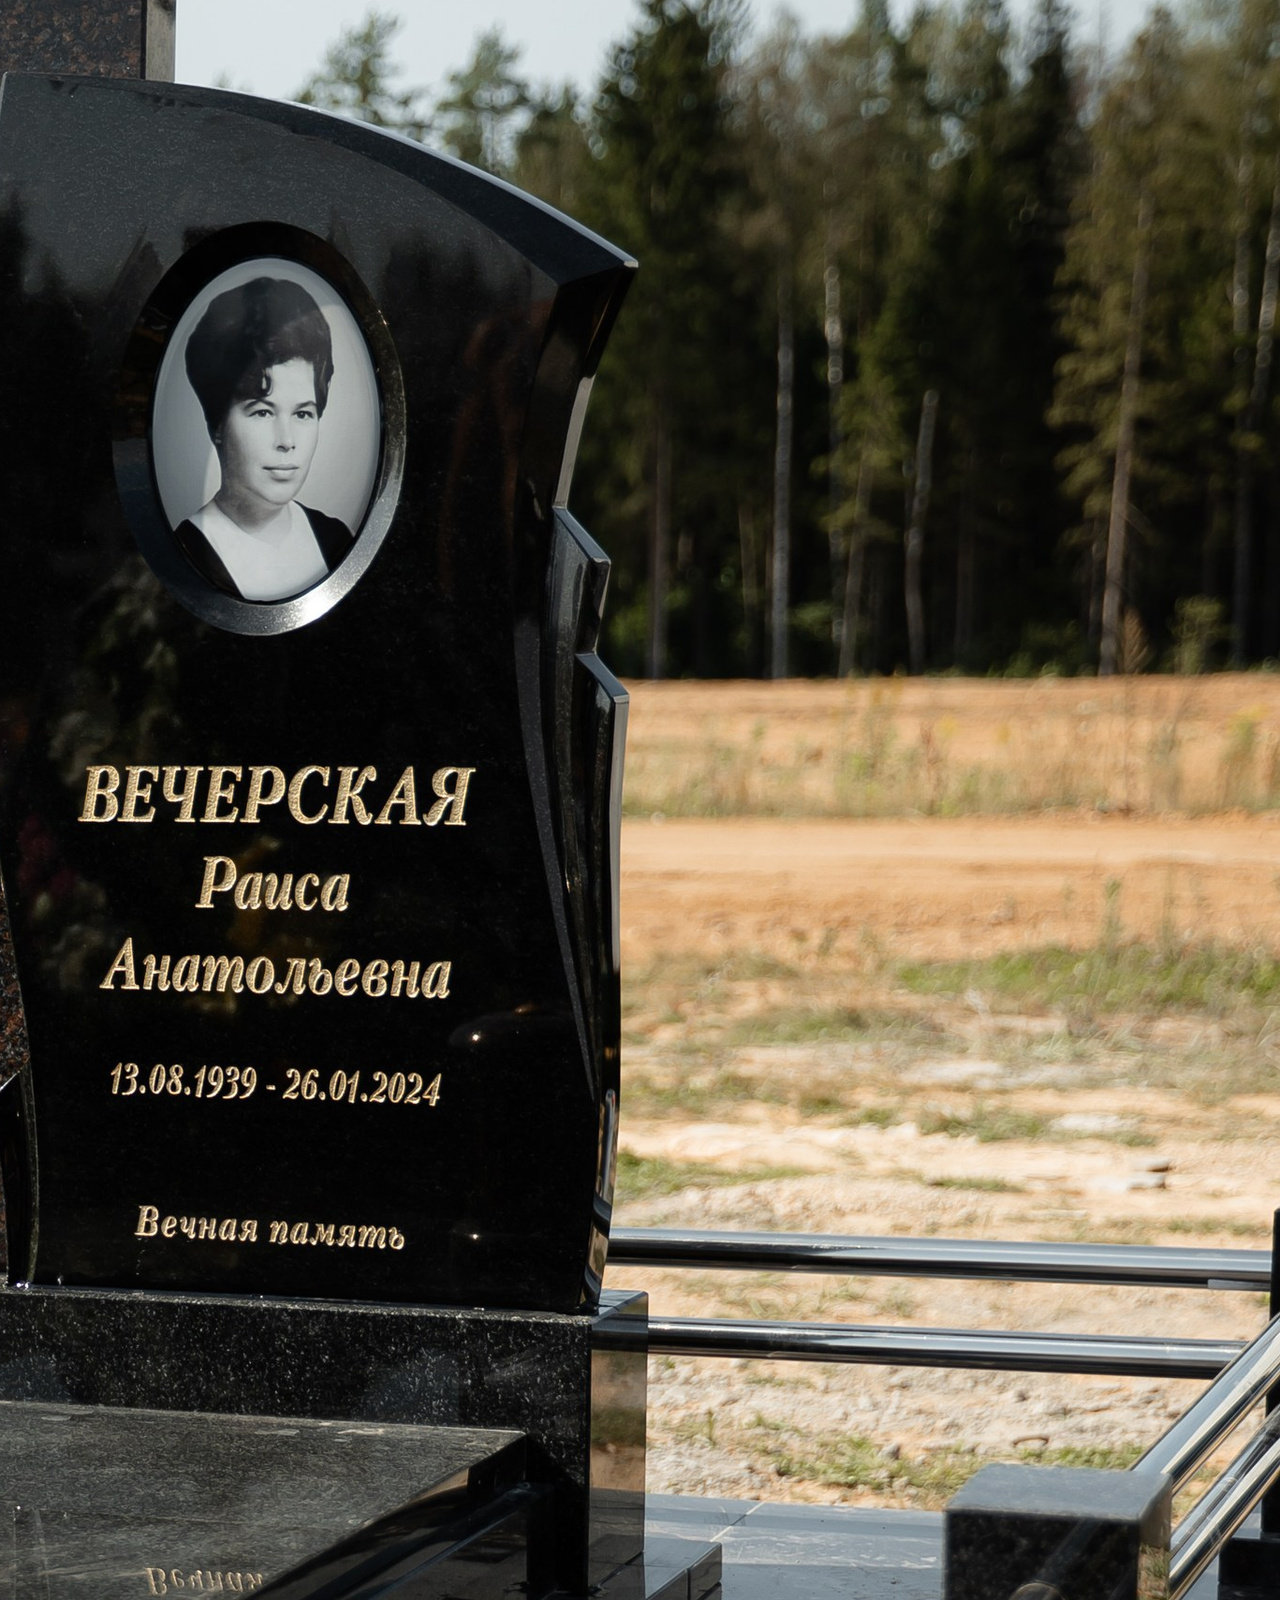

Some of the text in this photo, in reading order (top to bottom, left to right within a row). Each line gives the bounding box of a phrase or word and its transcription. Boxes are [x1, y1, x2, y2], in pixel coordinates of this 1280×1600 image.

[78, 765, 476, 826] ВЕЧЕРСКАЯ
[194, 855, 351, 912] Раиса
[99, 937, 452, 999] Анатольевна
[110, 1062, 258, 1100] 13.08.1939
[282, 1068, 443, 1107] 26.01.2024
[133, 1205, 406, 1251] Вечная память
